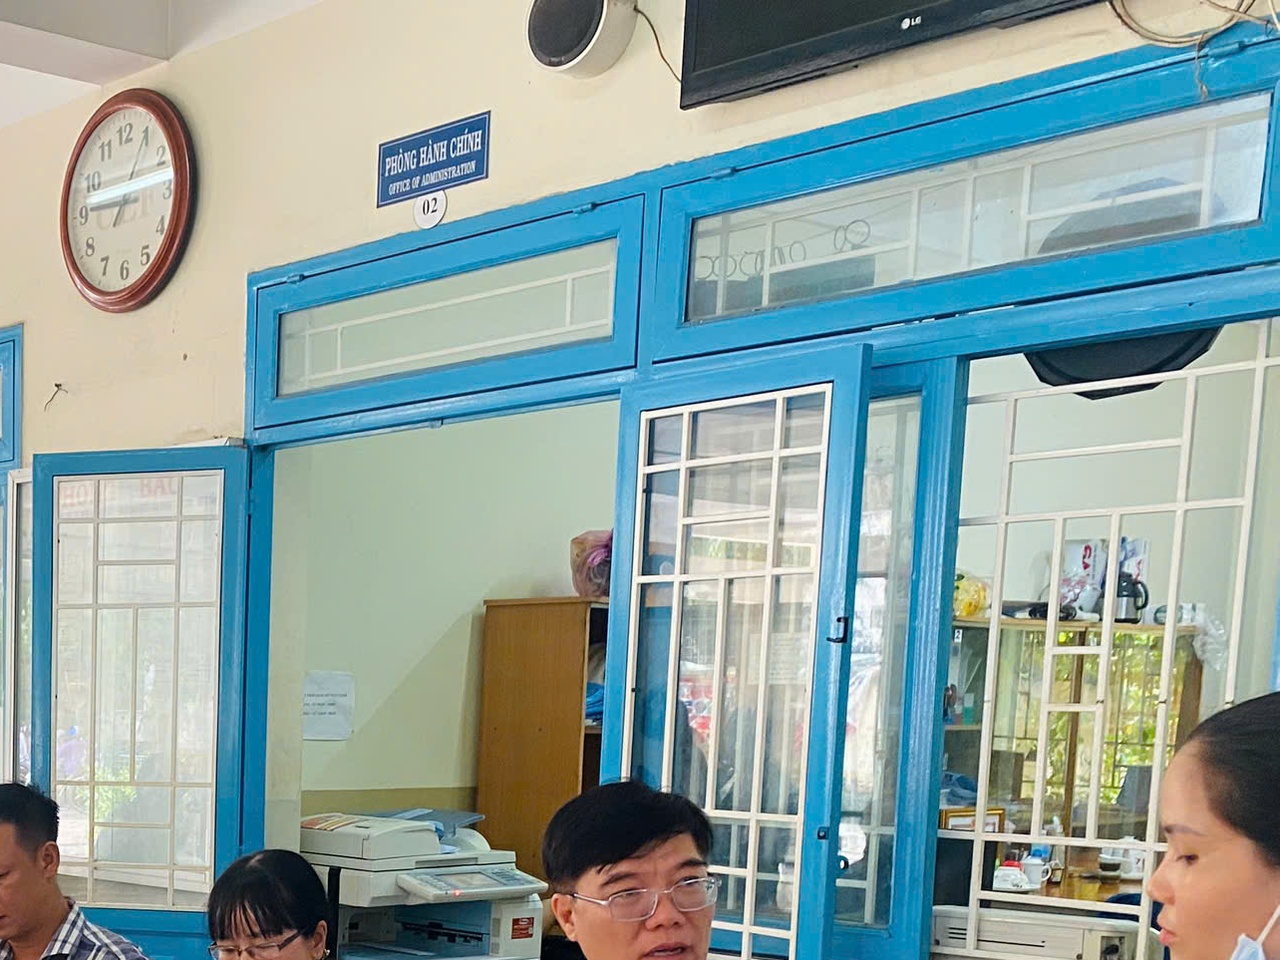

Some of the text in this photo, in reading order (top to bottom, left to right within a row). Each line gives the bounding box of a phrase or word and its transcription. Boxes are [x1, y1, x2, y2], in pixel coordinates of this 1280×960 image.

[911, 15, 922, 26] LG
[116, 122, 133, 146] 12
[142, 125, 149, 147] 1
[99, 139, 111, 162] 11
[156, 145, 166, 167] 2
[384, 128, 482, 177] PHÒNG HÀNH CHÍNH
[84, 171, 101, 193] 10
[388, 160, 476, 195] OFFICE OF ADMINISTRATION
[163, 180, 173, 199] 3
[79, 205, 89, 226] 9
[422, 197, 438, 215] 02
[155, 215, 165, 236] 4
[85, 236, 95, 257] 8
[140, 244, 150, 266] 5
[100, 255, 110, 277] 7
[120, 259, 129, 281] 6
